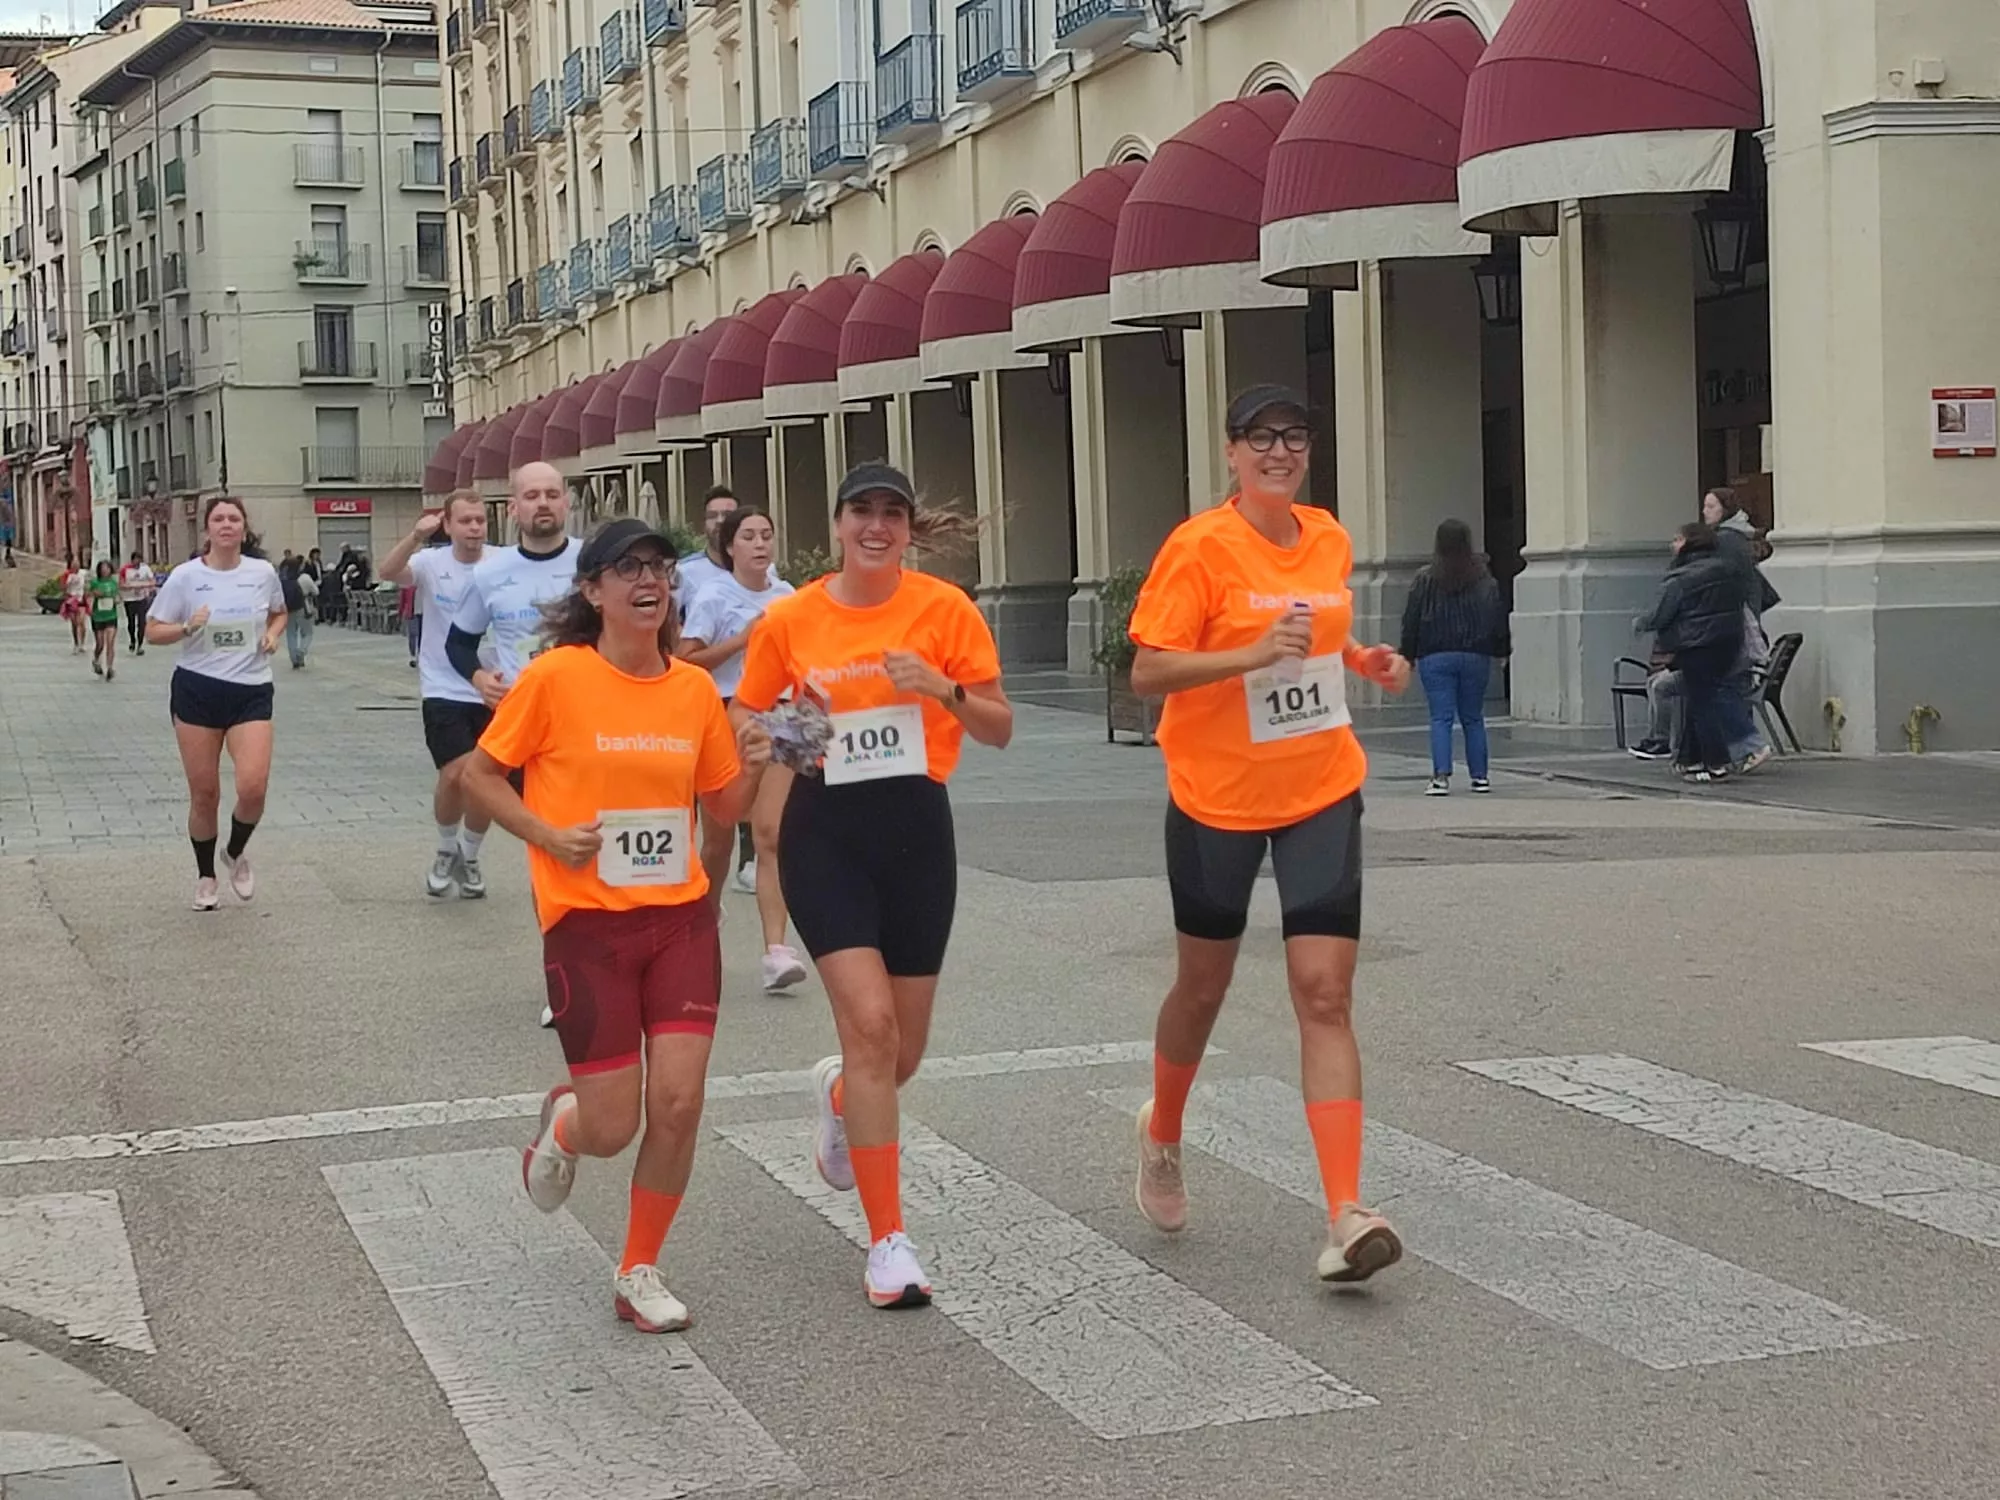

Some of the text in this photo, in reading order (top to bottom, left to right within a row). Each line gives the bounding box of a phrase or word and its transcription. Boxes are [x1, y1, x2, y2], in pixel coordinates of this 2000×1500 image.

[429, 302, 445, 399] HOSTAL
[1265, 682, 1321, 714] 101
[1268, 706, 1331, 726] CAROLINA
[839, 725, 900, 753] 100
[615, 829, 673, 855] 102
[632, 856, 665, 866] ROSA
